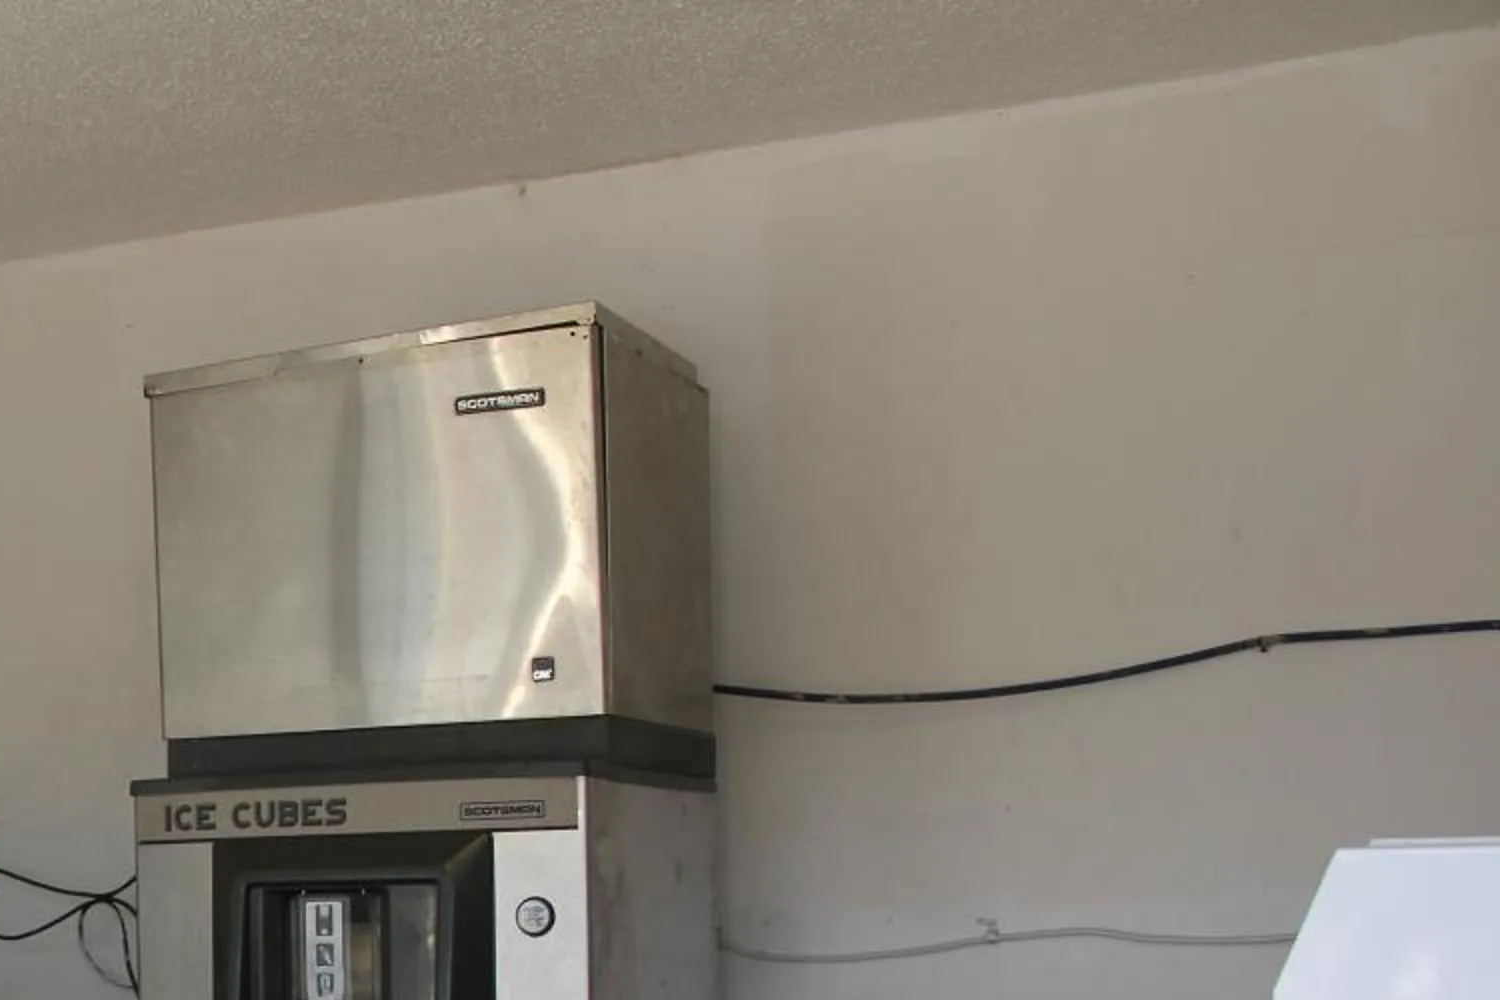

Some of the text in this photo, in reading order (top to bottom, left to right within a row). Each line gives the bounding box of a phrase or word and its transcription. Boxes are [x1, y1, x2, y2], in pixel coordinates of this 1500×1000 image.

[457, 391, 540, 411] SCOTSMAN
[164, 797, 348, 832] ICE CUBES
[464, 802, 541, 818] SCOTSMAN
